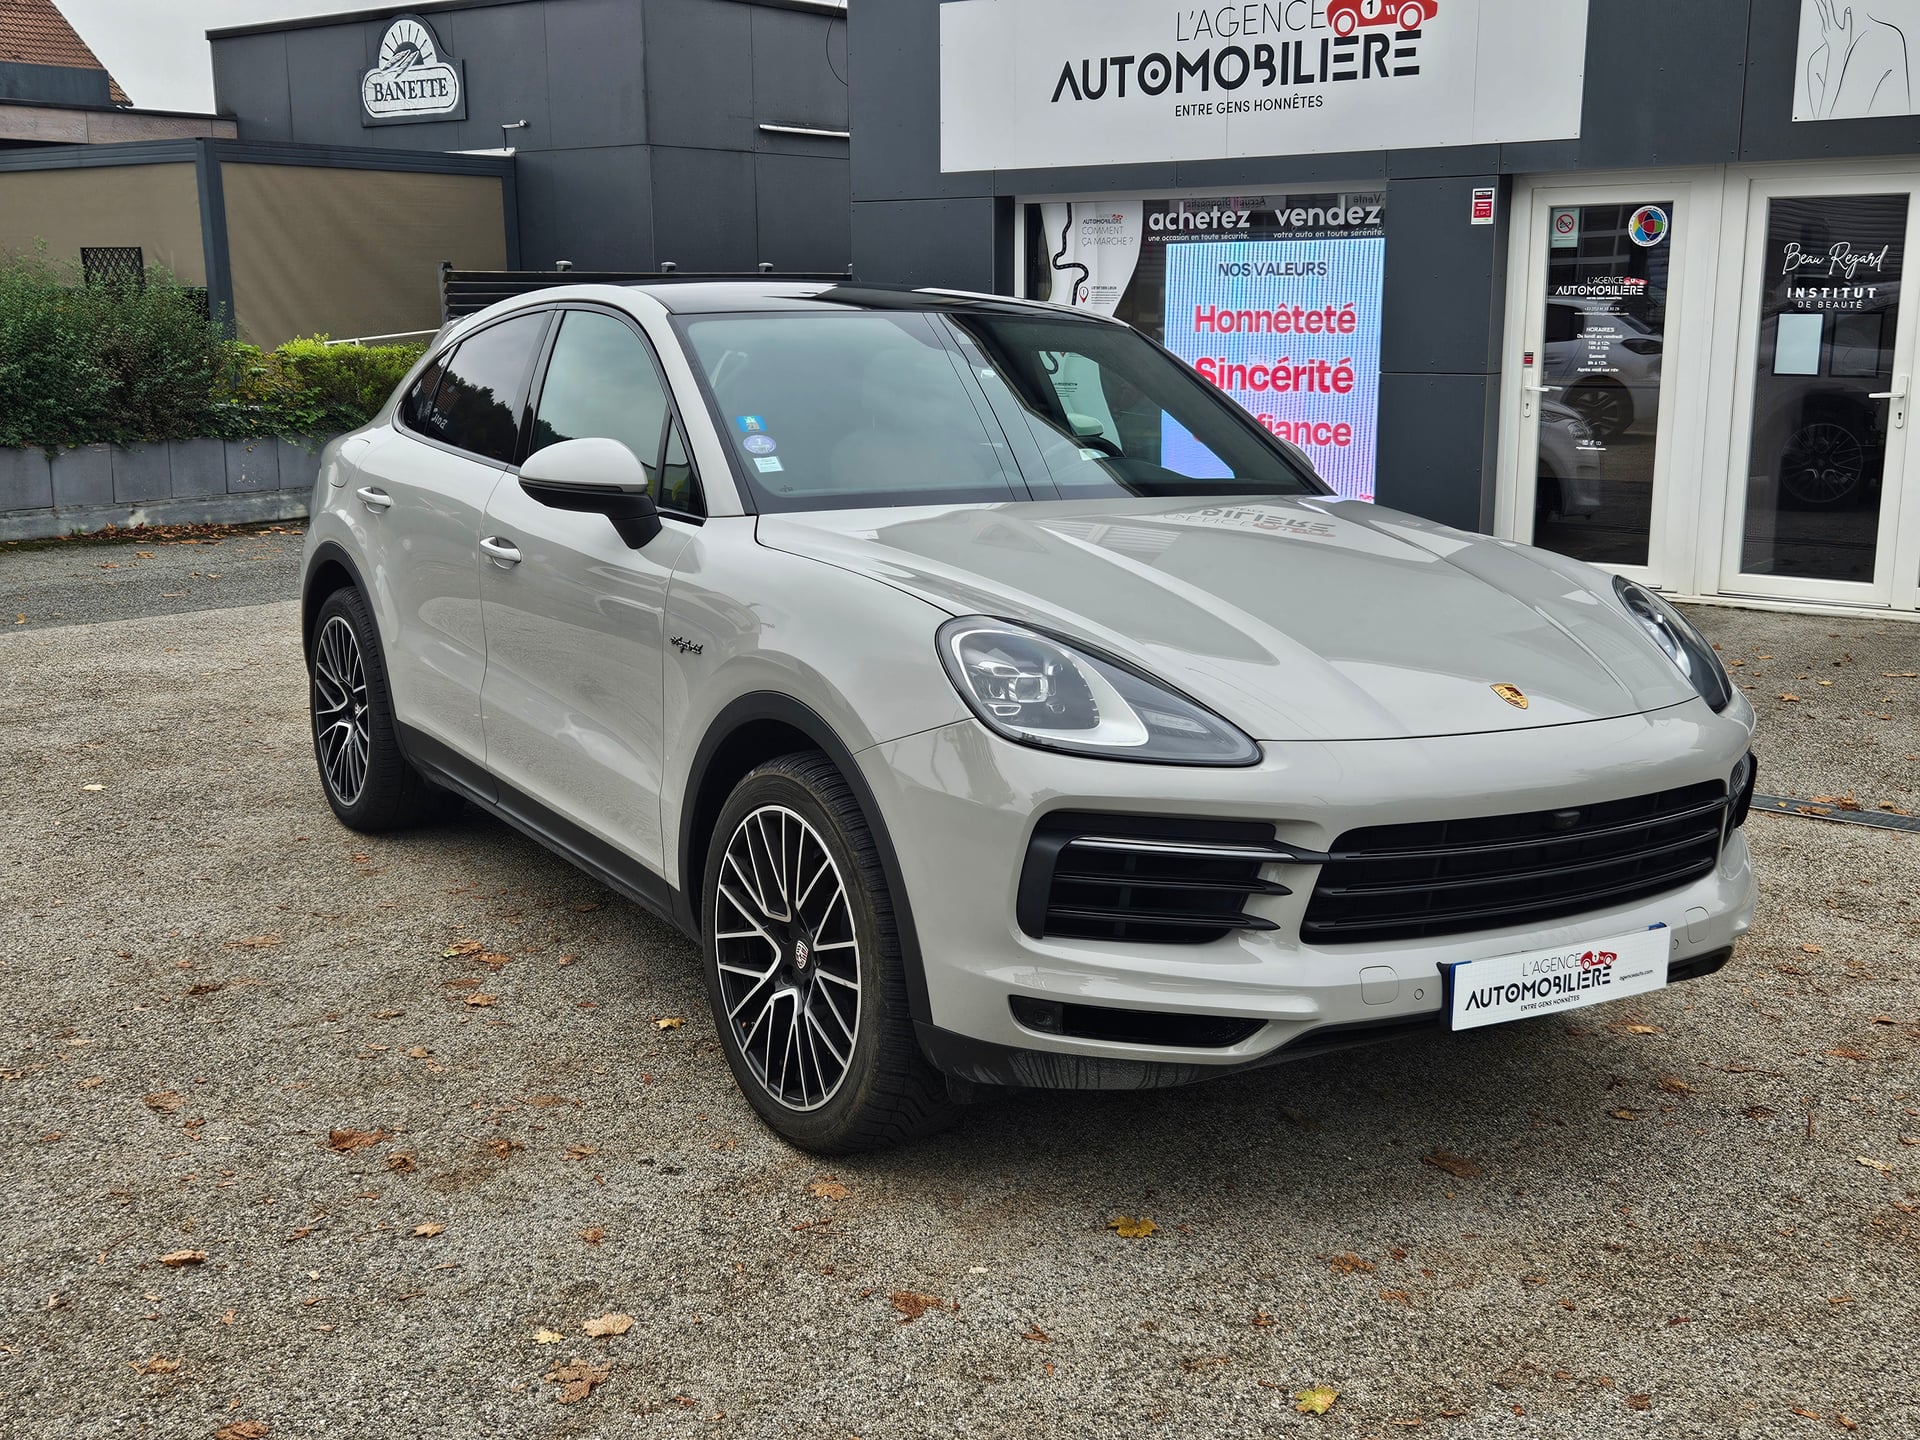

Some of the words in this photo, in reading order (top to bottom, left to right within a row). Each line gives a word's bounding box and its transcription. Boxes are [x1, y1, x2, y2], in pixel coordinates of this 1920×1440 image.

[1176, 0, 1326, 42] L'AGENCE
[373, 77, 449, 102] BANETTE
[1175, 103, 1213, 117] ENTRE
[1216, 100, 1250, 115] GENS
[1254, 93, 1324, 111] HONNÊTES
[1148, 201, 1251, 231] achetez
[1274, 195, 1381, 227] vendez
[1081, 226, 1124, 236] COMMENT
[1093, 236, 1127, 246] MARCHE
[1161, 233, 1190, 241] occasion
[1219, 262, 1251, 277] NOS
[1252, 261, 1327, 277] VALEURS
[1782, 242, 1825, 275] Beau
[1829, 242, 1889, 279] Regard
[1587, 276, 1624, 285] L'AGENCE
[1787, 287, 1877, 299] INSTITUT
[1797, 301, 1812, 309] DE
[1817, 299, 1863, 309] BEAUTÉ
[1194, 302, 1356, 334] Honnêteté
[1194, 356, 1354, 394] Sincérité
[1522, 953, 1582, 977] L'AGENCE
[1520, 1002, 1537, 1012] ENTRE
[1538, 1000, 1552, 1009] GENS
[1553, 994, 1580, 1006] HONNÊTES
